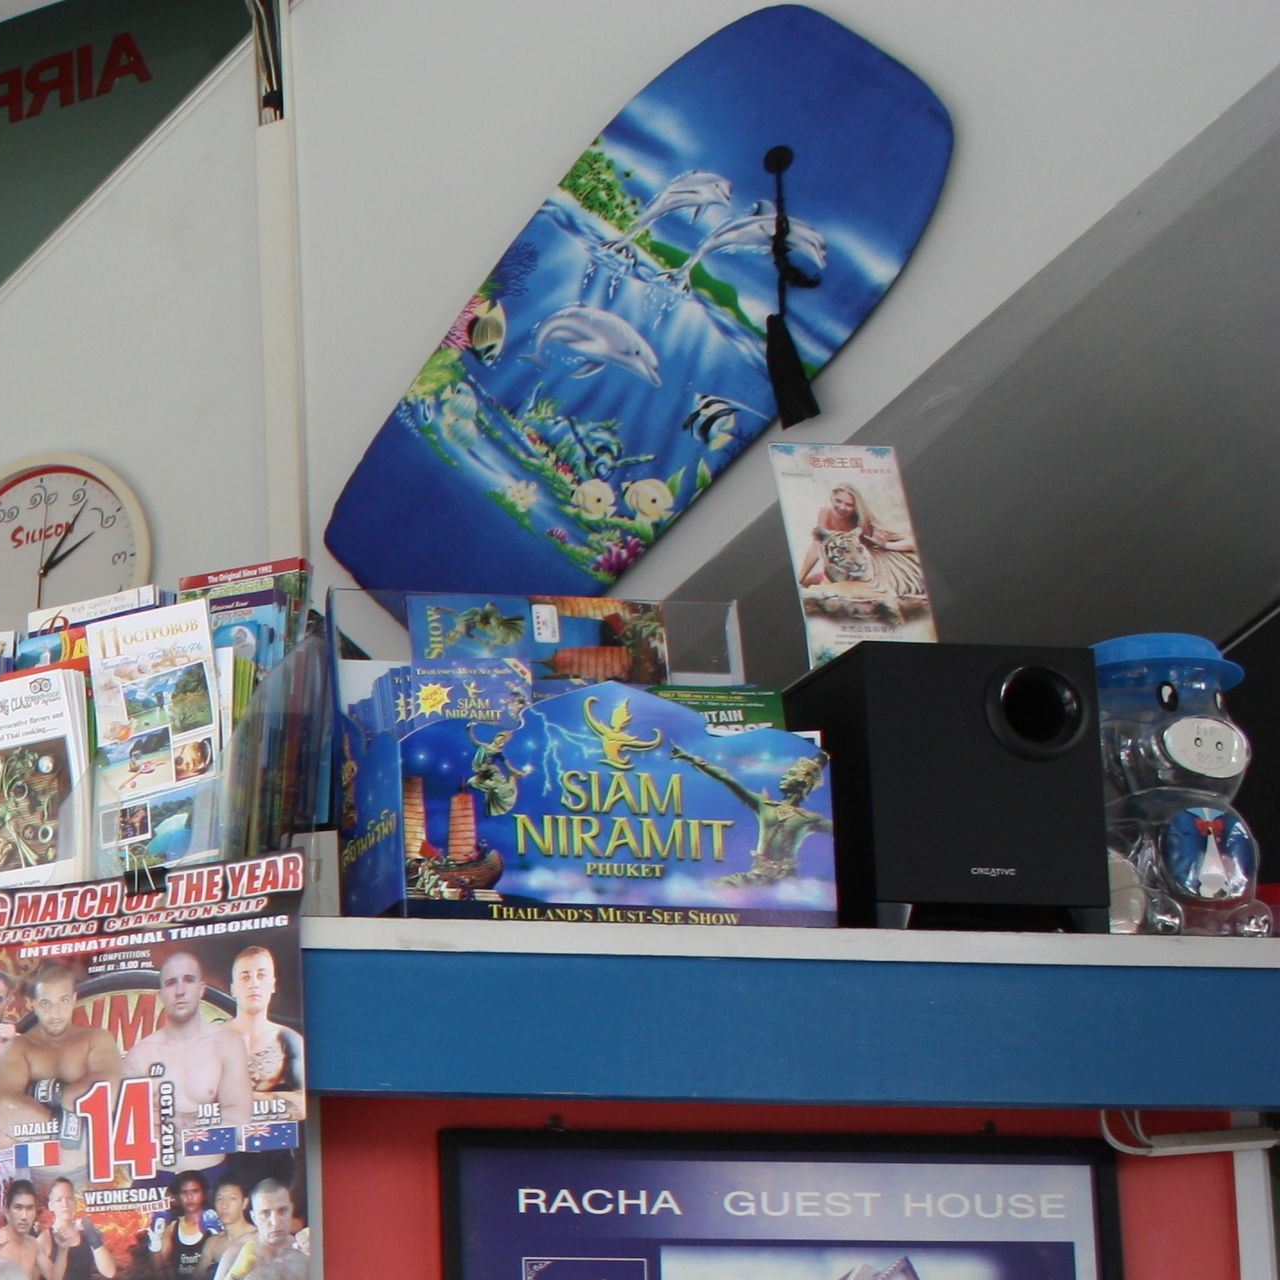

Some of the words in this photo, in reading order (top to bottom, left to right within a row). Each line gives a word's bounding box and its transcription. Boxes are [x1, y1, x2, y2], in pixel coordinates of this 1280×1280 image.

[10, 520, 76, 549] SILICON
[122, 620, 199, 646] ОСТРОВОВ
[444, 708, 504, 722] NIRAMIT
[560, 769, 684, 815] SIAM
[513, 813, 734, 862] NIRAMIT
[585, 861, 665, 878] PHUKET
[970, 866, 1017, 878] CREATIVE
[10, 882, 122, 928] MATCH
[165, 865, 221, 906] THE
[224, 852, 305, 897] YEAR
[103, 896, 269, 932] CHAMPIONSHIP
[688, 909, 739, 926] SHOW
[18, 924, 166, 959] INTERNATIONAL
[167, 914, 289, 941] THAIBOXING
[99, 949, 152, 963] COMPETITIONS
[76, 1077, 162, 1183] 14
[84, 1186, 169, 1206] WEDNESDAY
[517, 1187, 683, 1217] RACHA
[722, 1189, 881, 1219] GUEST
[903, 1191, 1068, 1220] HOUSE
